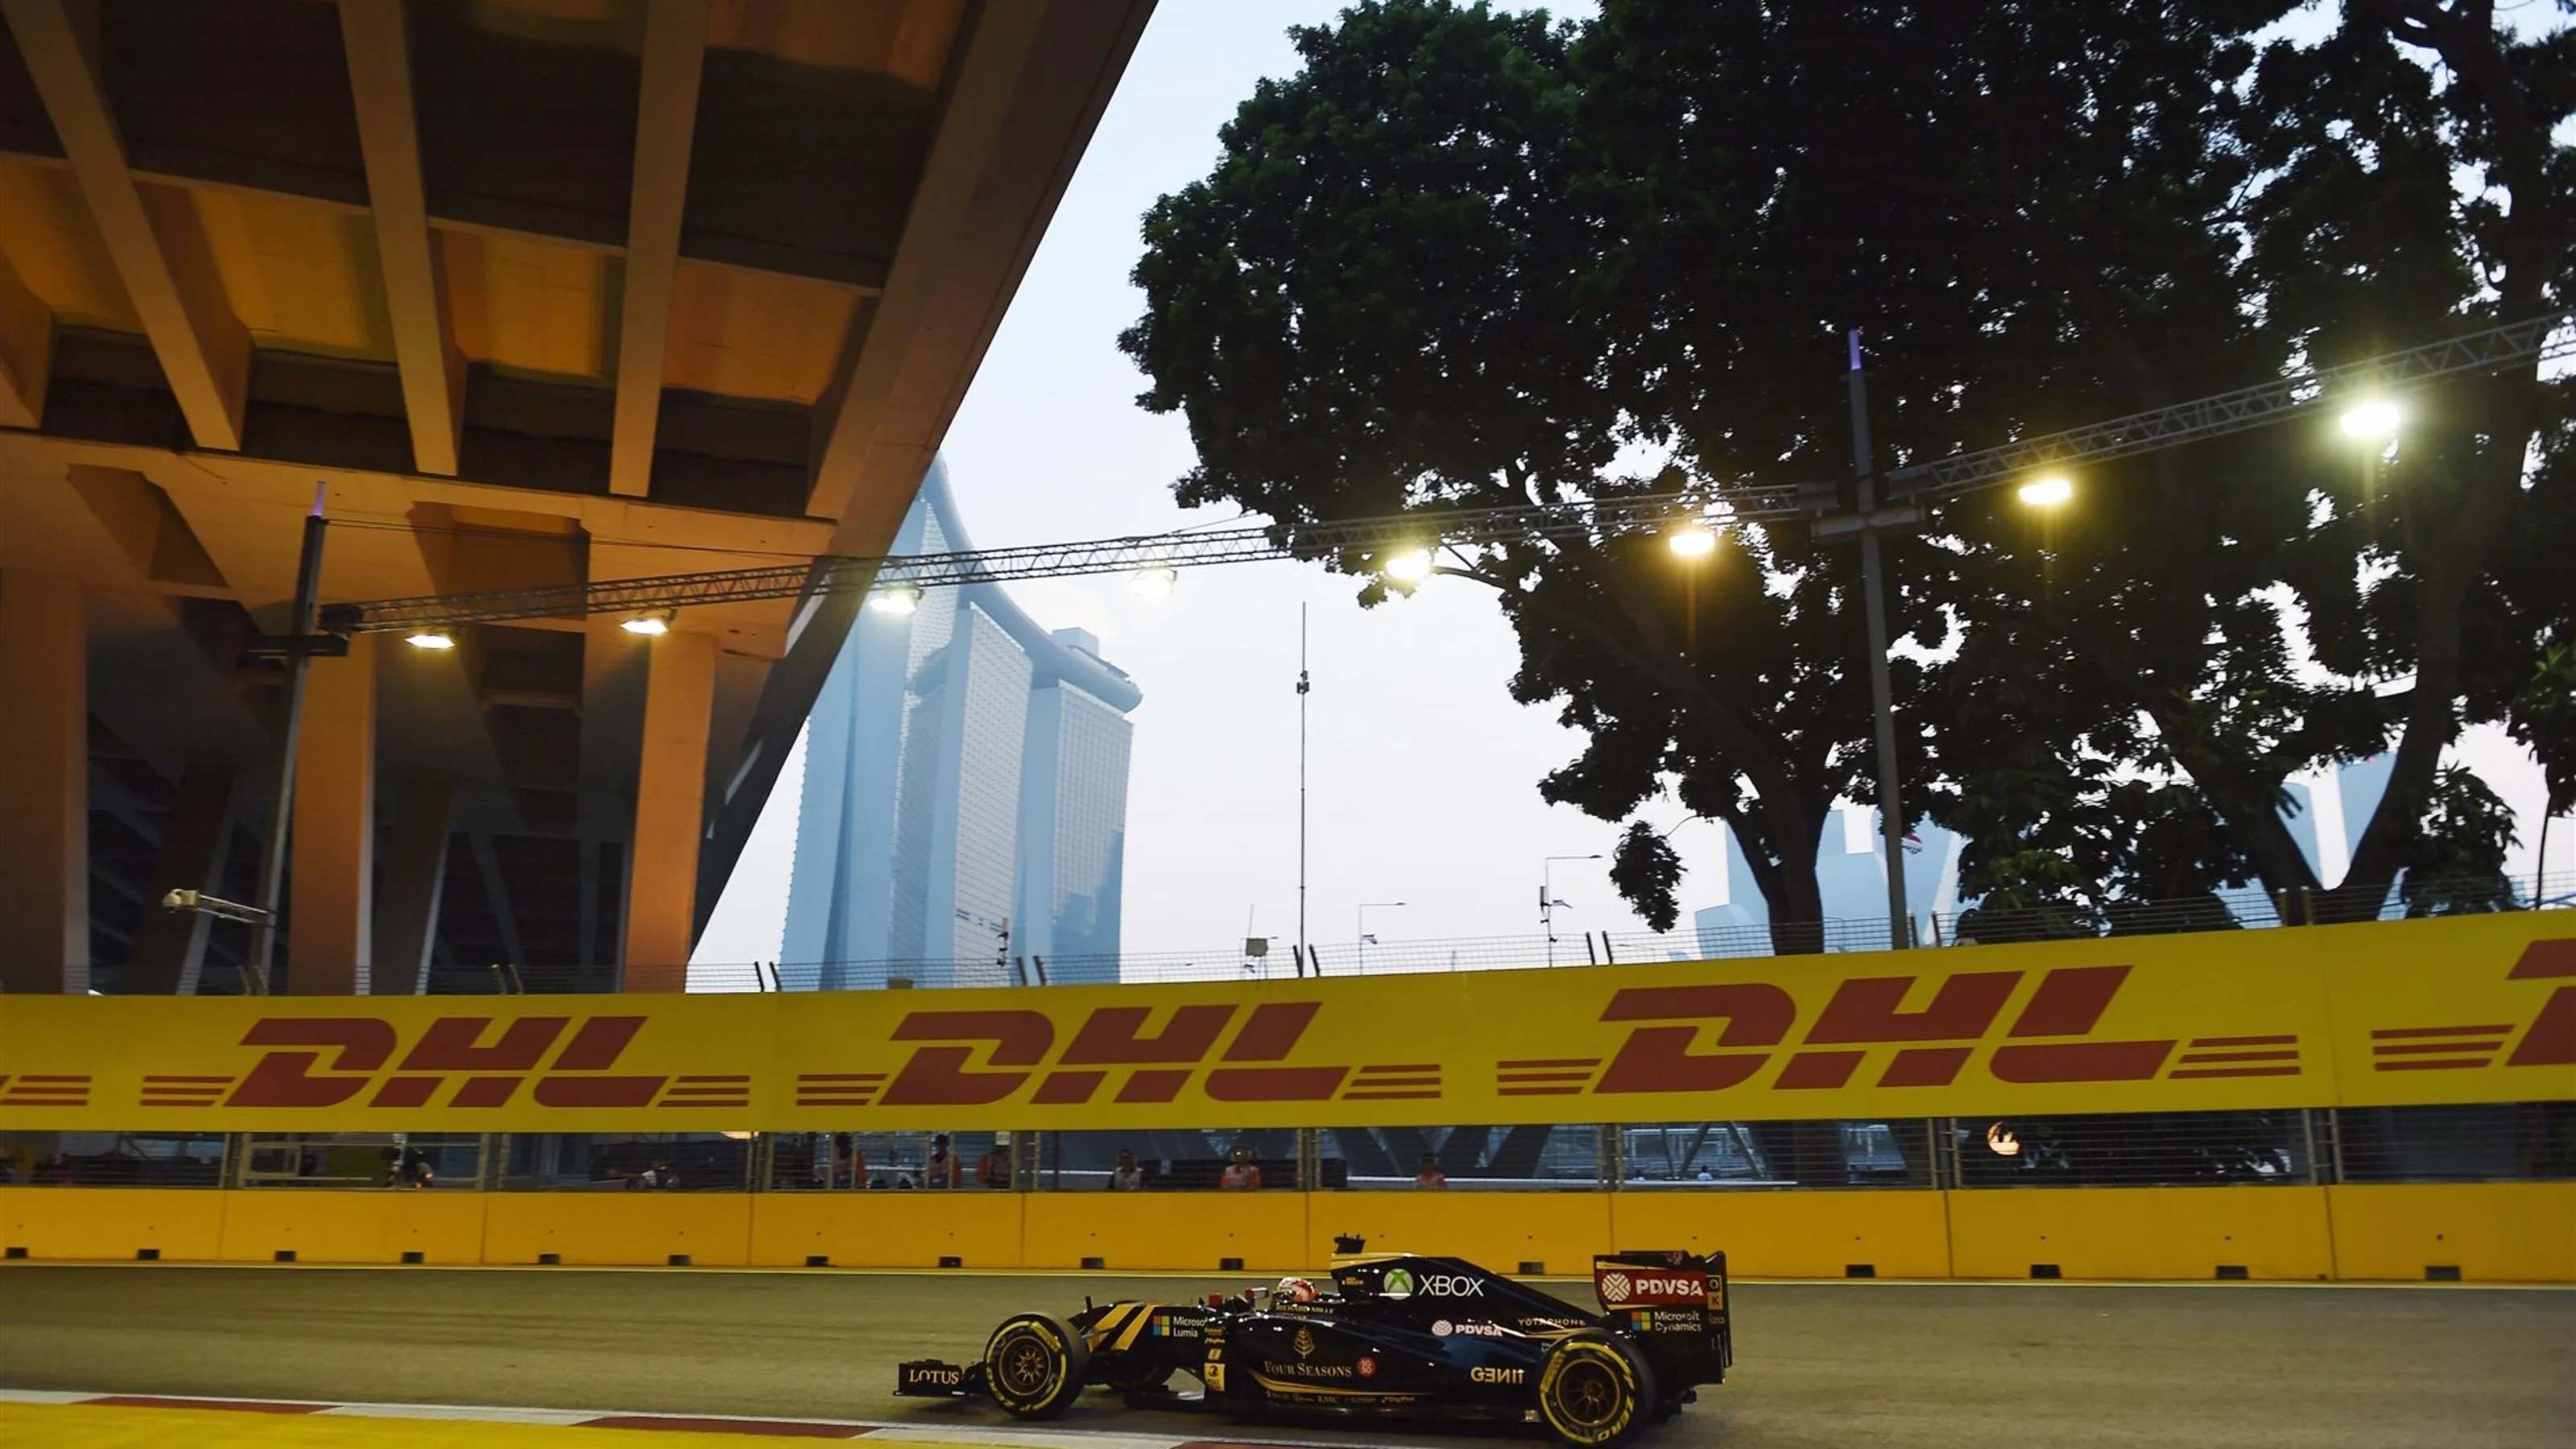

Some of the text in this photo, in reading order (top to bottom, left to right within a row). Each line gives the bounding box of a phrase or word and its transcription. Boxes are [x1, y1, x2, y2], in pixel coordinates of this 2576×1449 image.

[1593, 965, 2178, 1094] DHL
[878, 1001, 1350, 1105] DHL
[224, 1017, 668, 1108] DHL
[1419, 1274, 1485, 1297] XBOX
[1635, 1279, 1704, 1297] PDVSA
[1173, 1327, 1198, 1337] Lumia
[1455, 1323, 1503, 1337] PDVSA
[1655, 1321, 1701, 1333] Dynamics
[908, 1369, 960, 1385] LOTUS
